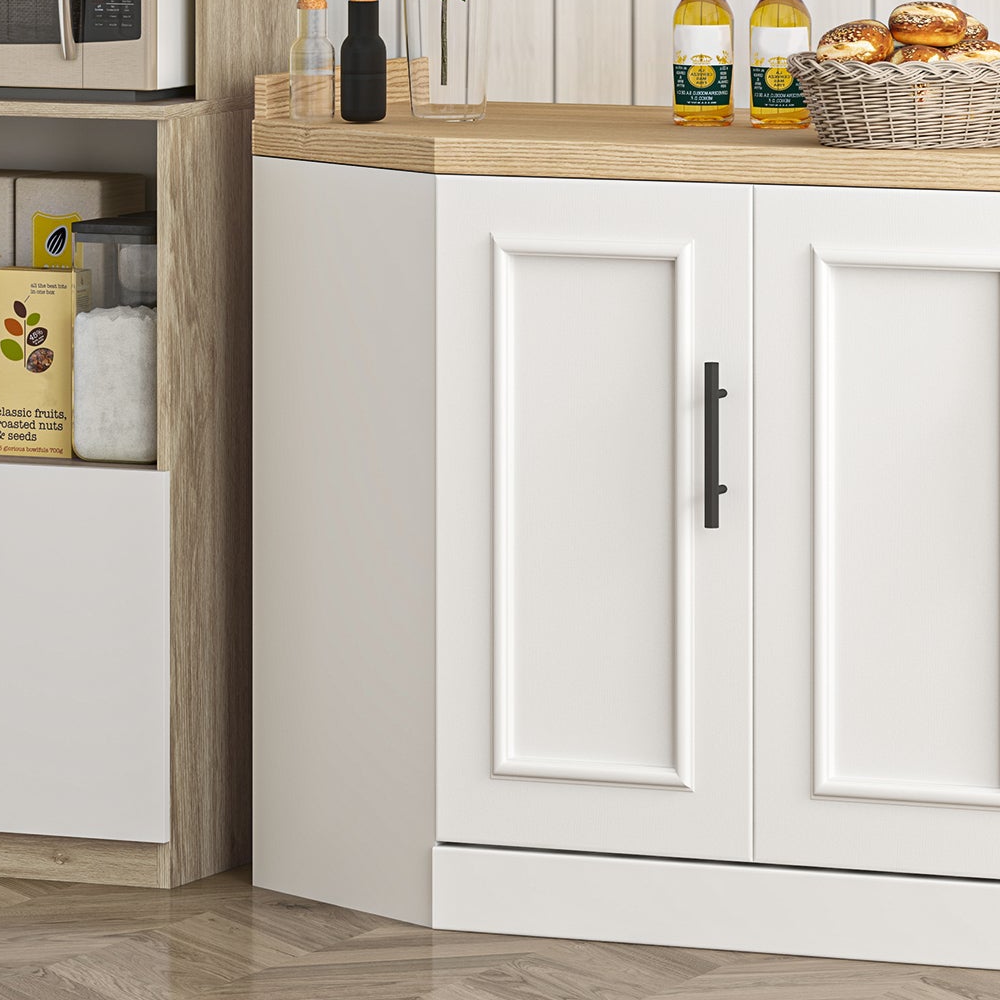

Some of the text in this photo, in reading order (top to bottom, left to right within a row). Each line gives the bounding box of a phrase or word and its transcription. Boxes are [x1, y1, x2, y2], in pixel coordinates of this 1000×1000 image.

[34, 409, 67, 420] fruits,
[39, 421, 64, 431] nuts
[7, 432, 37, 441] seeds
